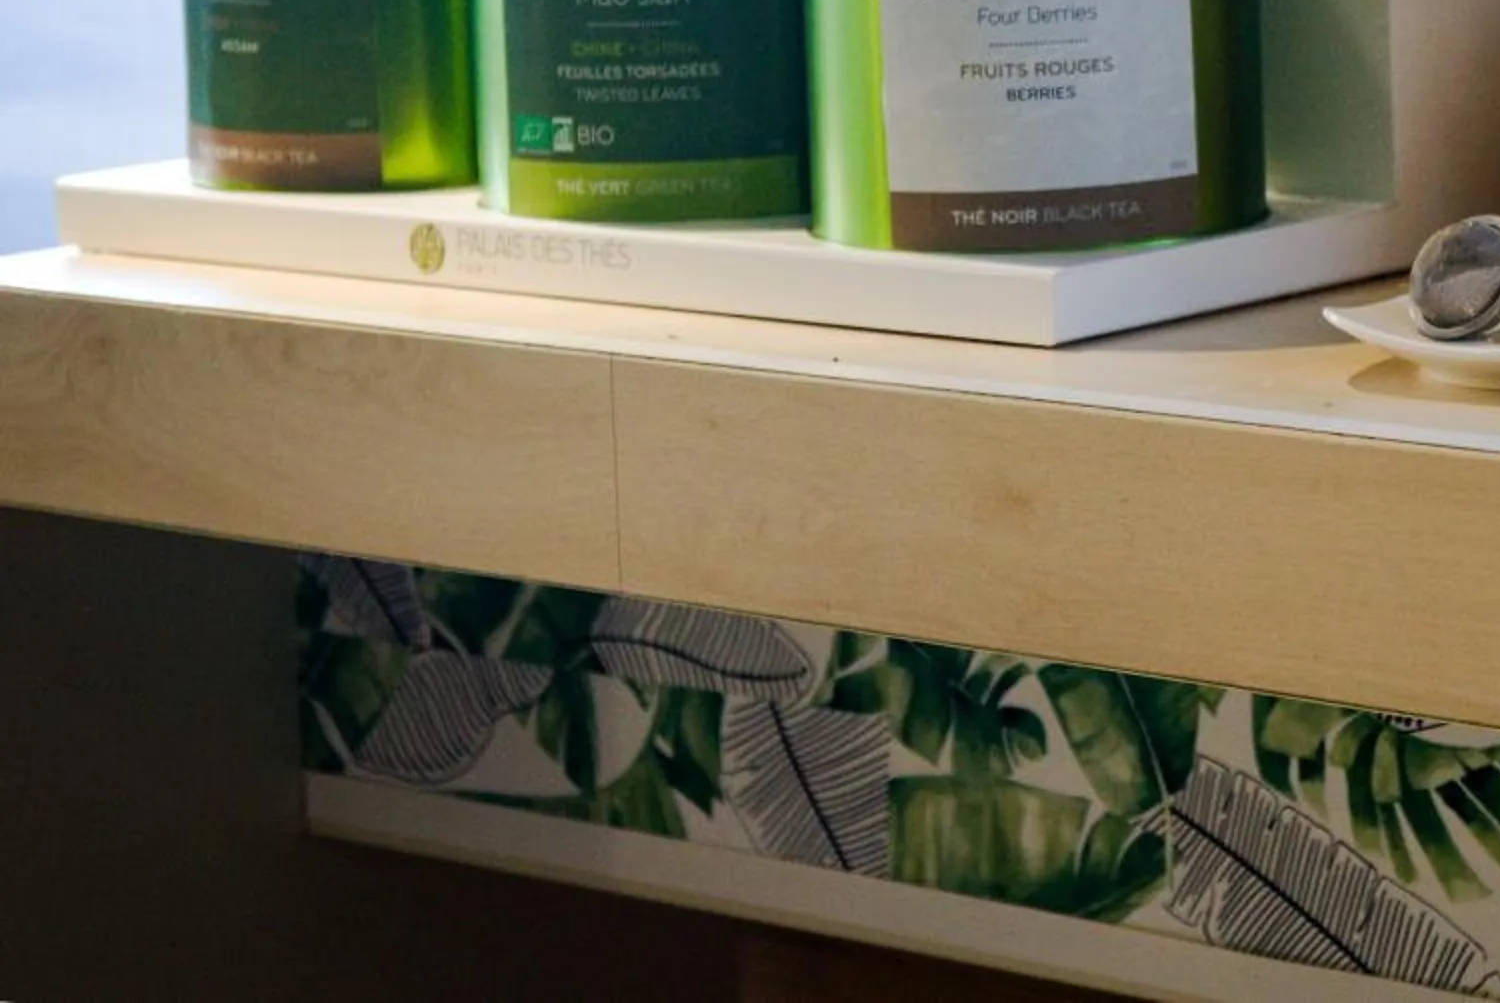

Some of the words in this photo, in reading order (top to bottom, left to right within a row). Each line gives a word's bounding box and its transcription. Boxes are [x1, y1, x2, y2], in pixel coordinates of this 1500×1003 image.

[976, 6, 1021, 27] Four
[1027, 3, 1099, 25] Berries
[556, 63, 623, 81] FEUILLES
[959, 61, 1030, 81] FRUITS
[1034, 55, 1117, 79] ROUGES
[1006, 84, 1078, 103] BERRIES
[577, 123, 616, 146] BIO
[588, 179, 631, 196] VERT
[990, 207, 1038, 227] NOIR
[1042, 203, 1103, 224] BLACK
[1108, 199, 1144, 219] TEA
